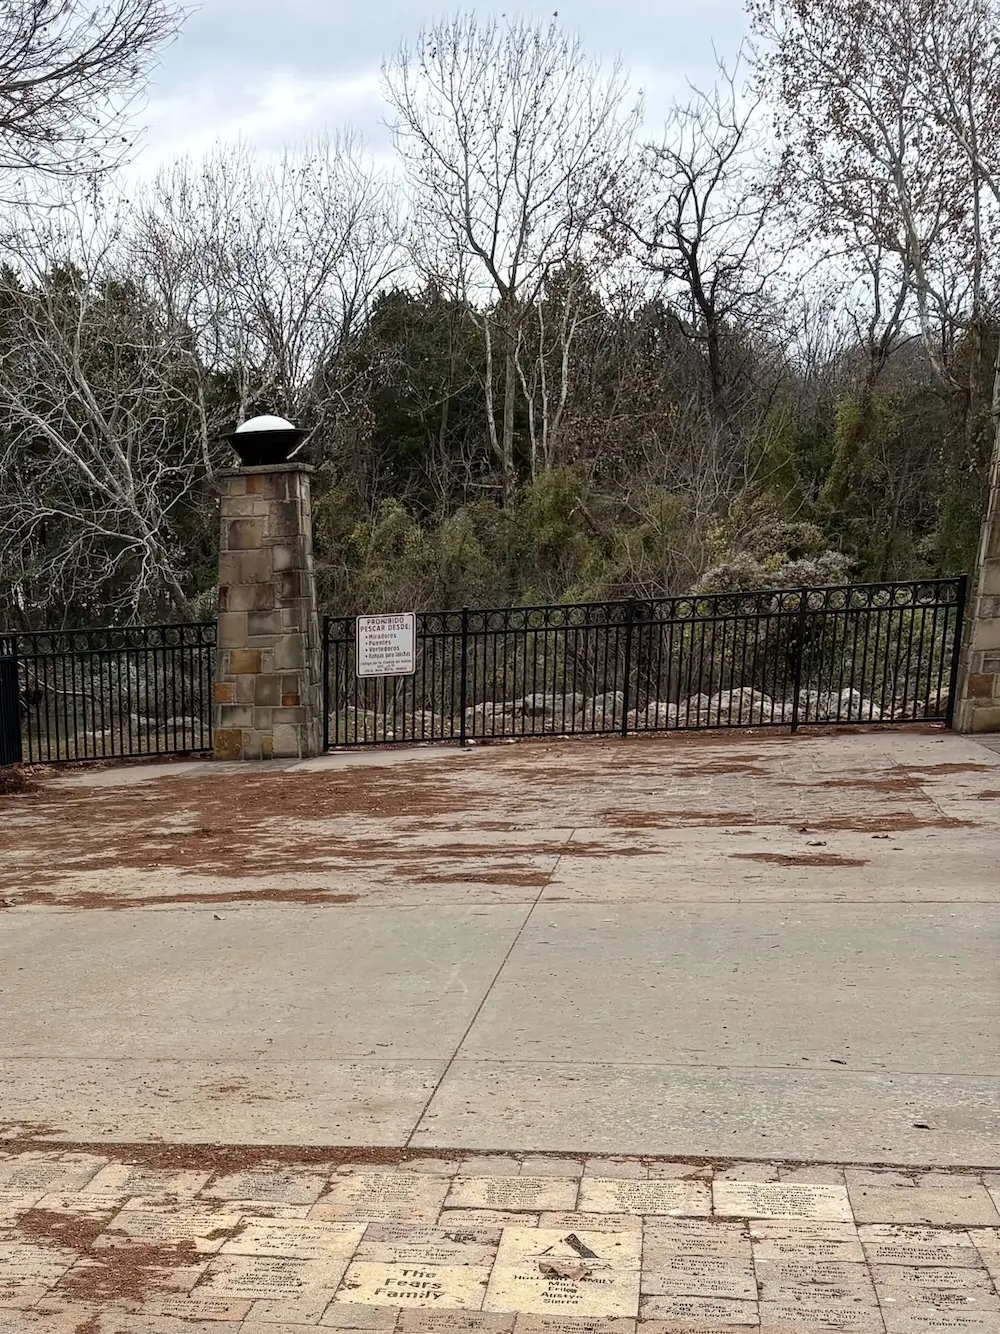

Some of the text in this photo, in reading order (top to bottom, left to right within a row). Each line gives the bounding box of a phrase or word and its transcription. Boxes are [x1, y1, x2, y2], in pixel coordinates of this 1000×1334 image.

[367, 617, 404, 625] PROHIBIDO
[399, 1269, 437, 1279] The
[384, 1278, 443, 1290] Fears
[373, 1287, 446, 1301] Family
